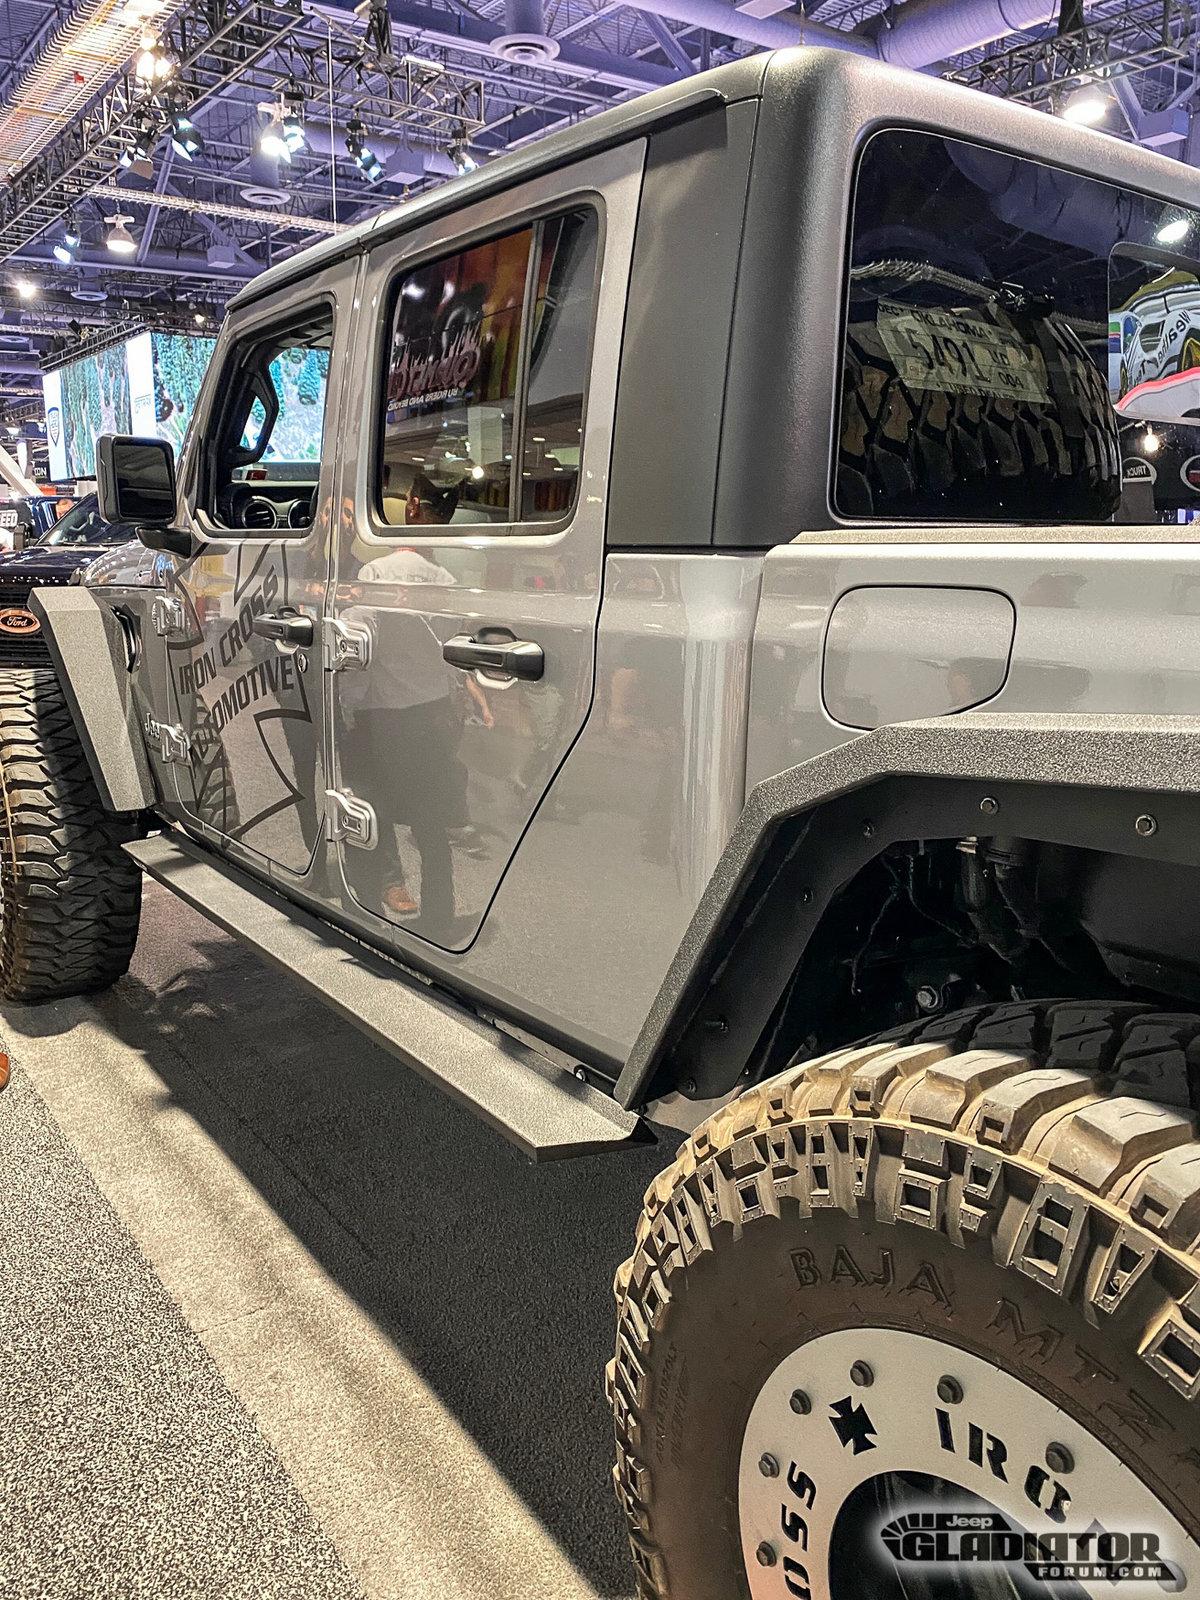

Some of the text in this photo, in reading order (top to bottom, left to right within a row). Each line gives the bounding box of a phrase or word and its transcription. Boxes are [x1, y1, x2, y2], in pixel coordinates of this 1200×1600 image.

[910, 309, 990, 340] OKLAHOMA
[6, 615, 28, 627] Ford
[179, 564, 279, 695] IRON CROSS
[788, 1242, 954, 1311] BAJA
